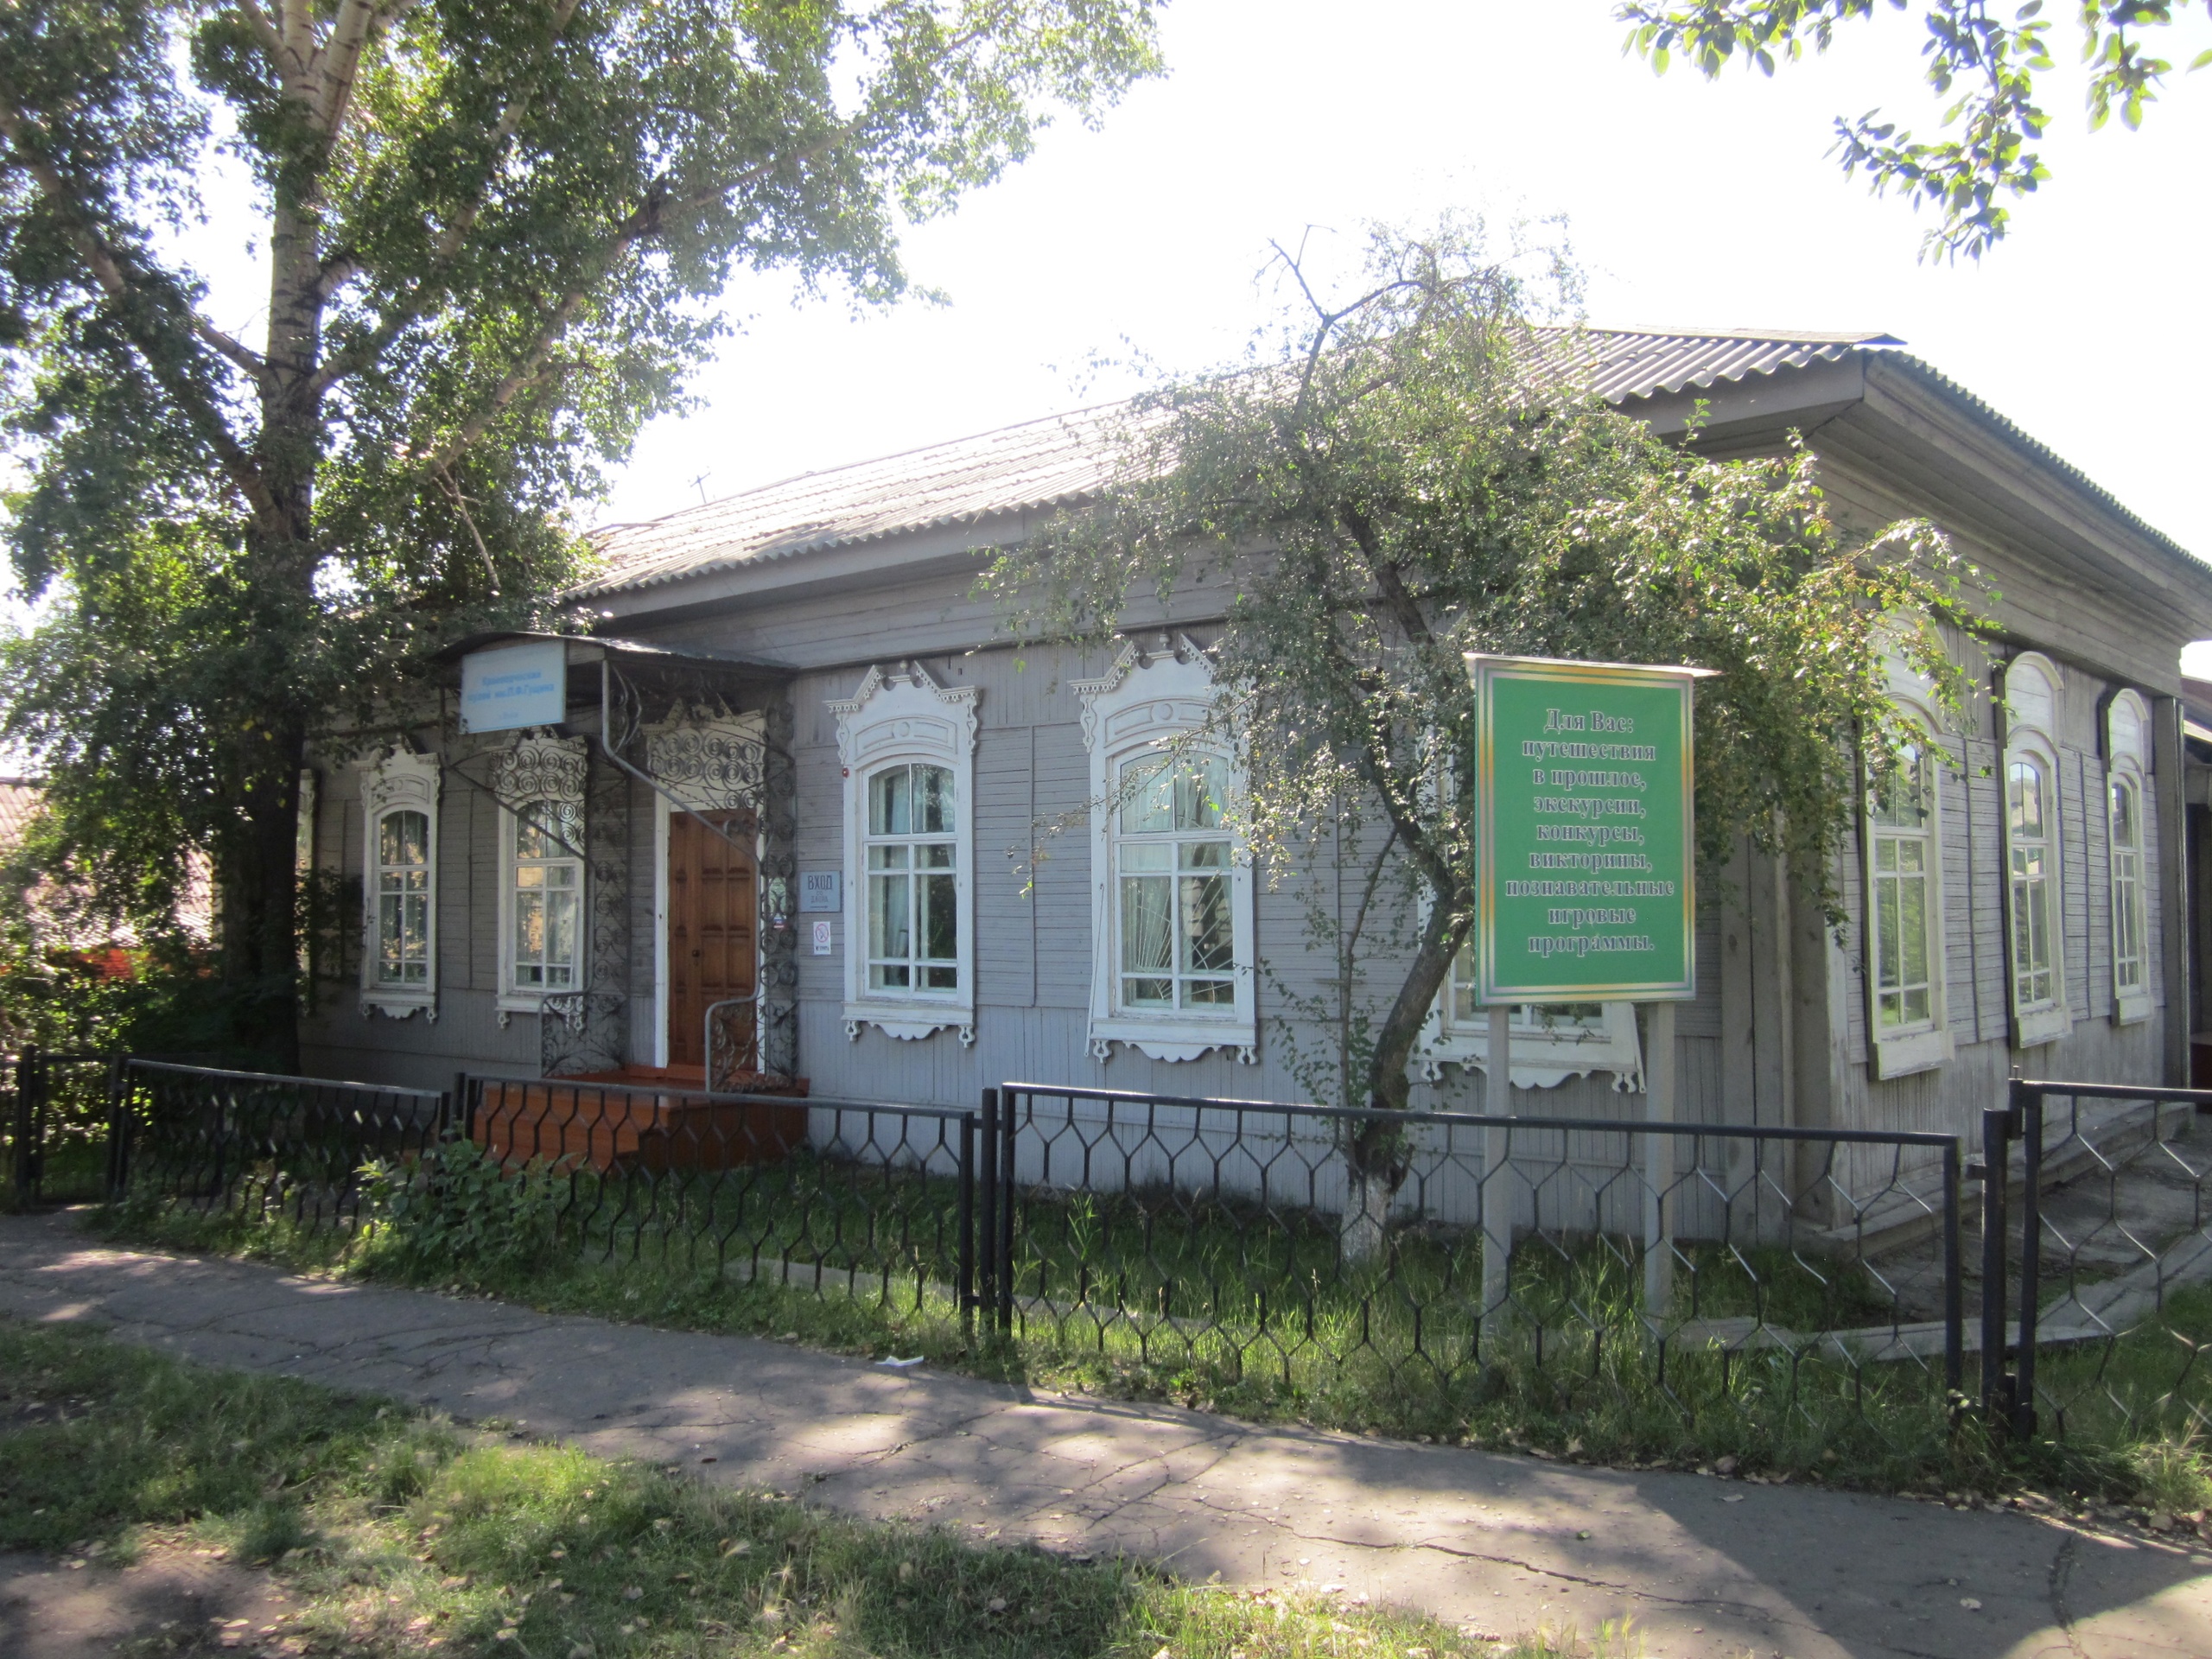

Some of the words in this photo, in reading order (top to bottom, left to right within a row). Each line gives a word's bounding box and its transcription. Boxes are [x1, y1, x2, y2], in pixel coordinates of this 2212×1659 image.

[1543, 709, 1585, 734] Для
[1591, 711, 1634, 733] Вас:
[1522, 741, 1656, 762] путешествия
[1533, 769, 1545, 785] в
[1551, 769, 1646, 791] прошлое,
[1534, 797, 1646, 819] экскурсии,
[1536, 825, 1645, 847] конкурсы,
[1529, 852, 1653, 874] викторины,
[808, 875, 832, 890] ВХОД
[1506, 880, 1675, 897] познавательные
[1548, 908, 1637, 929] игровые
[1529, 935, 1655, 958] программы.
